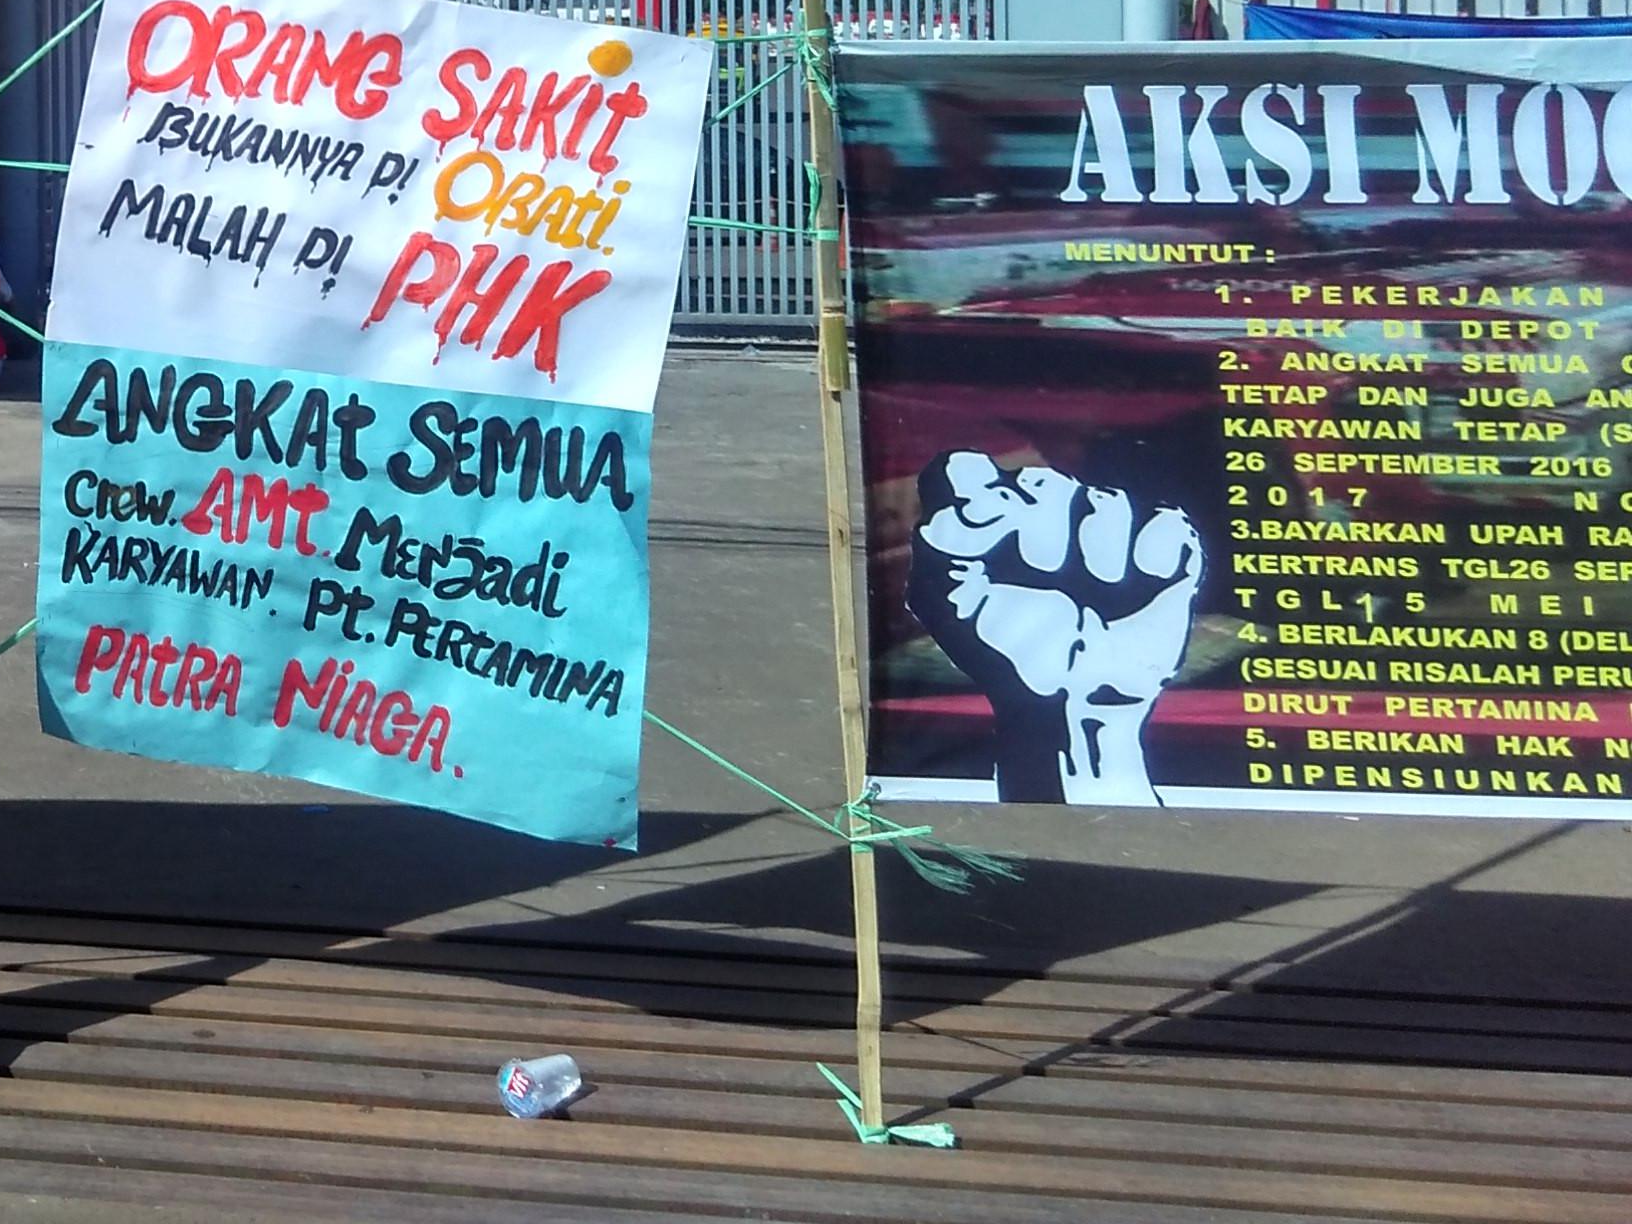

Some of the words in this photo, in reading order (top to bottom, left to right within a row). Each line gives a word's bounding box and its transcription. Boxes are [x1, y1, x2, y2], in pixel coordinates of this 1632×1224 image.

[136, 100, 366, 194] BUKANNYA
[1059, 83, 1369, 206] AKSI
[1066, 243, 1253, 263] MENUNTUT
[97, 177, 289, 289] MALAH
[359, 230, 613, 384] PHK
[1214, 285, 1253, 304] 1.
[1290, 285, 1606, 308] PEKERJAKAN
[1245, 317, 1346, 339] BAIK
[1382, 319, 1424, 339] DI
[1460, 319, 1601, 341] DEPOT
[1218, 351, 1249, 371] 2.
[1280, 350, 1429, 373] ANGKAT
[1461, 353, 1590, 374] SEMUA
[1221, 384, 1328, 405] TETAP
[1358, 386, 1428, 407] DAN
[1458, 387, 1556, 408] JUGA
[1223, 417, 1422, 441] KARYAWAN
[1453, 421, 1567, 442] TETAP
[386, 400, 636, 512] SEMUA
[1226, 451, 1265, 472] 26
[1292, 452, 1502, 476] SEPTEMBER
[1530, 456, 1613, 477] 2016
[1470, 524, 1564, 546] UPAH
[1233, 554, 1418, 578] KERTRANS
[1440, 558, 1551, 581] TGL26
[1490, 593, 1594, 616] MEI
[1236, 622, 1268, 643] 4.
[1278, 623, 1517, 650] BERLAKUKAN
[1528, 629, 1549, 651] 8
[1240, 657, 1377, 681] (SESUAI
[1389, 661, 1541, 686] RISALAH
[1243, 692, 1352, 715] DIRUT
[1385, 698, 1599, 722] PERTAMINA
[1245, 727, 1277, 750] 5.
[1307, 729, 1465, 755] BERIKAN
[1496, 735, 1572, 758] HAK
[1249, 763, 1622, 794] DIPENSIUNKAN
